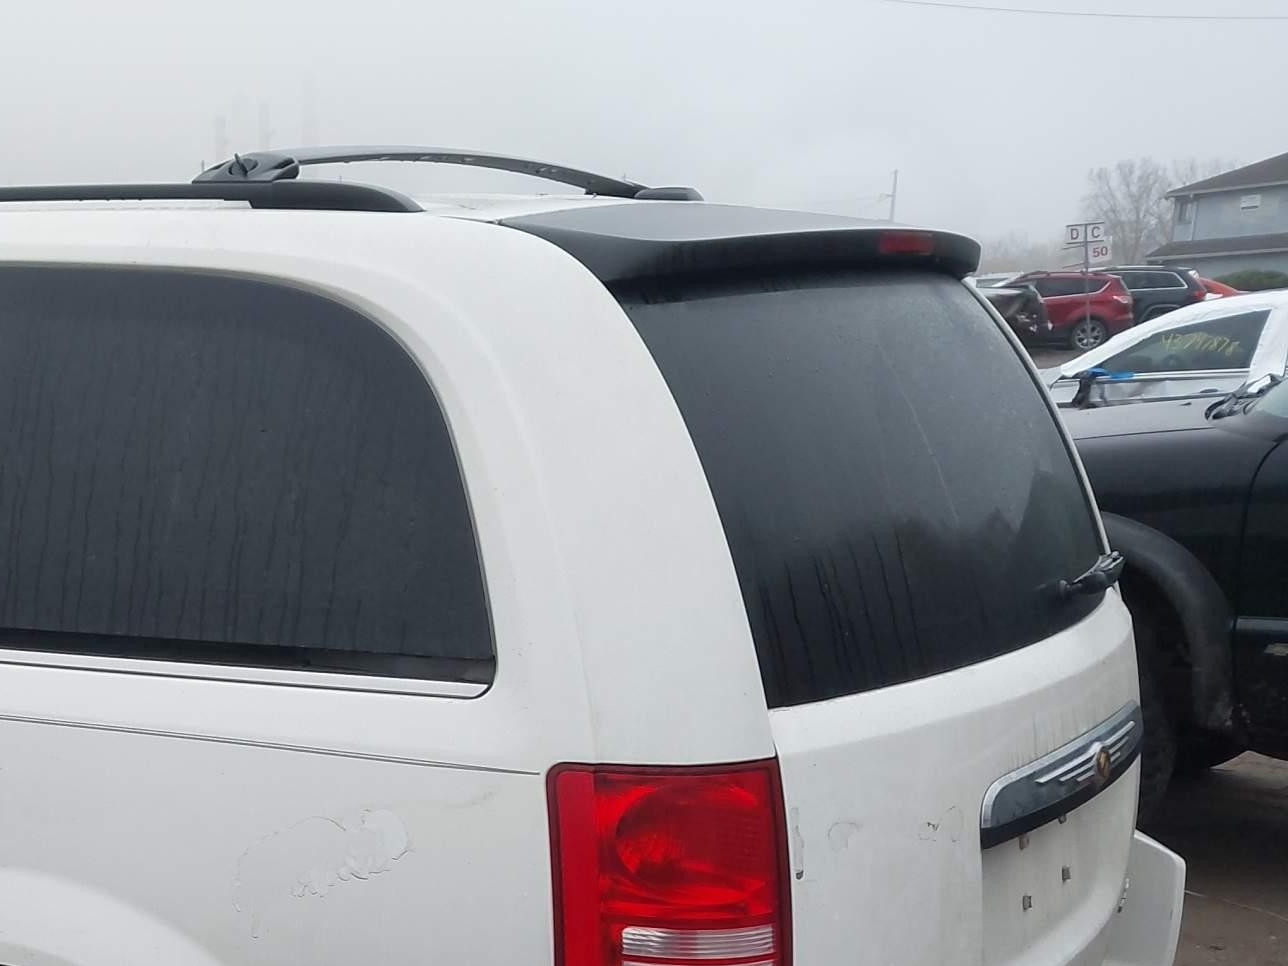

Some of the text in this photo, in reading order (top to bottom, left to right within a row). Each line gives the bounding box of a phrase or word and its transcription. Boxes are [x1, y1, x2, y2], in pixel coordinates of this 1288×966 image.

[1070, 227, 1079, 241] D
[1091, 226, 1101, 239] C
[1092, 246, 1108, 258] 50
